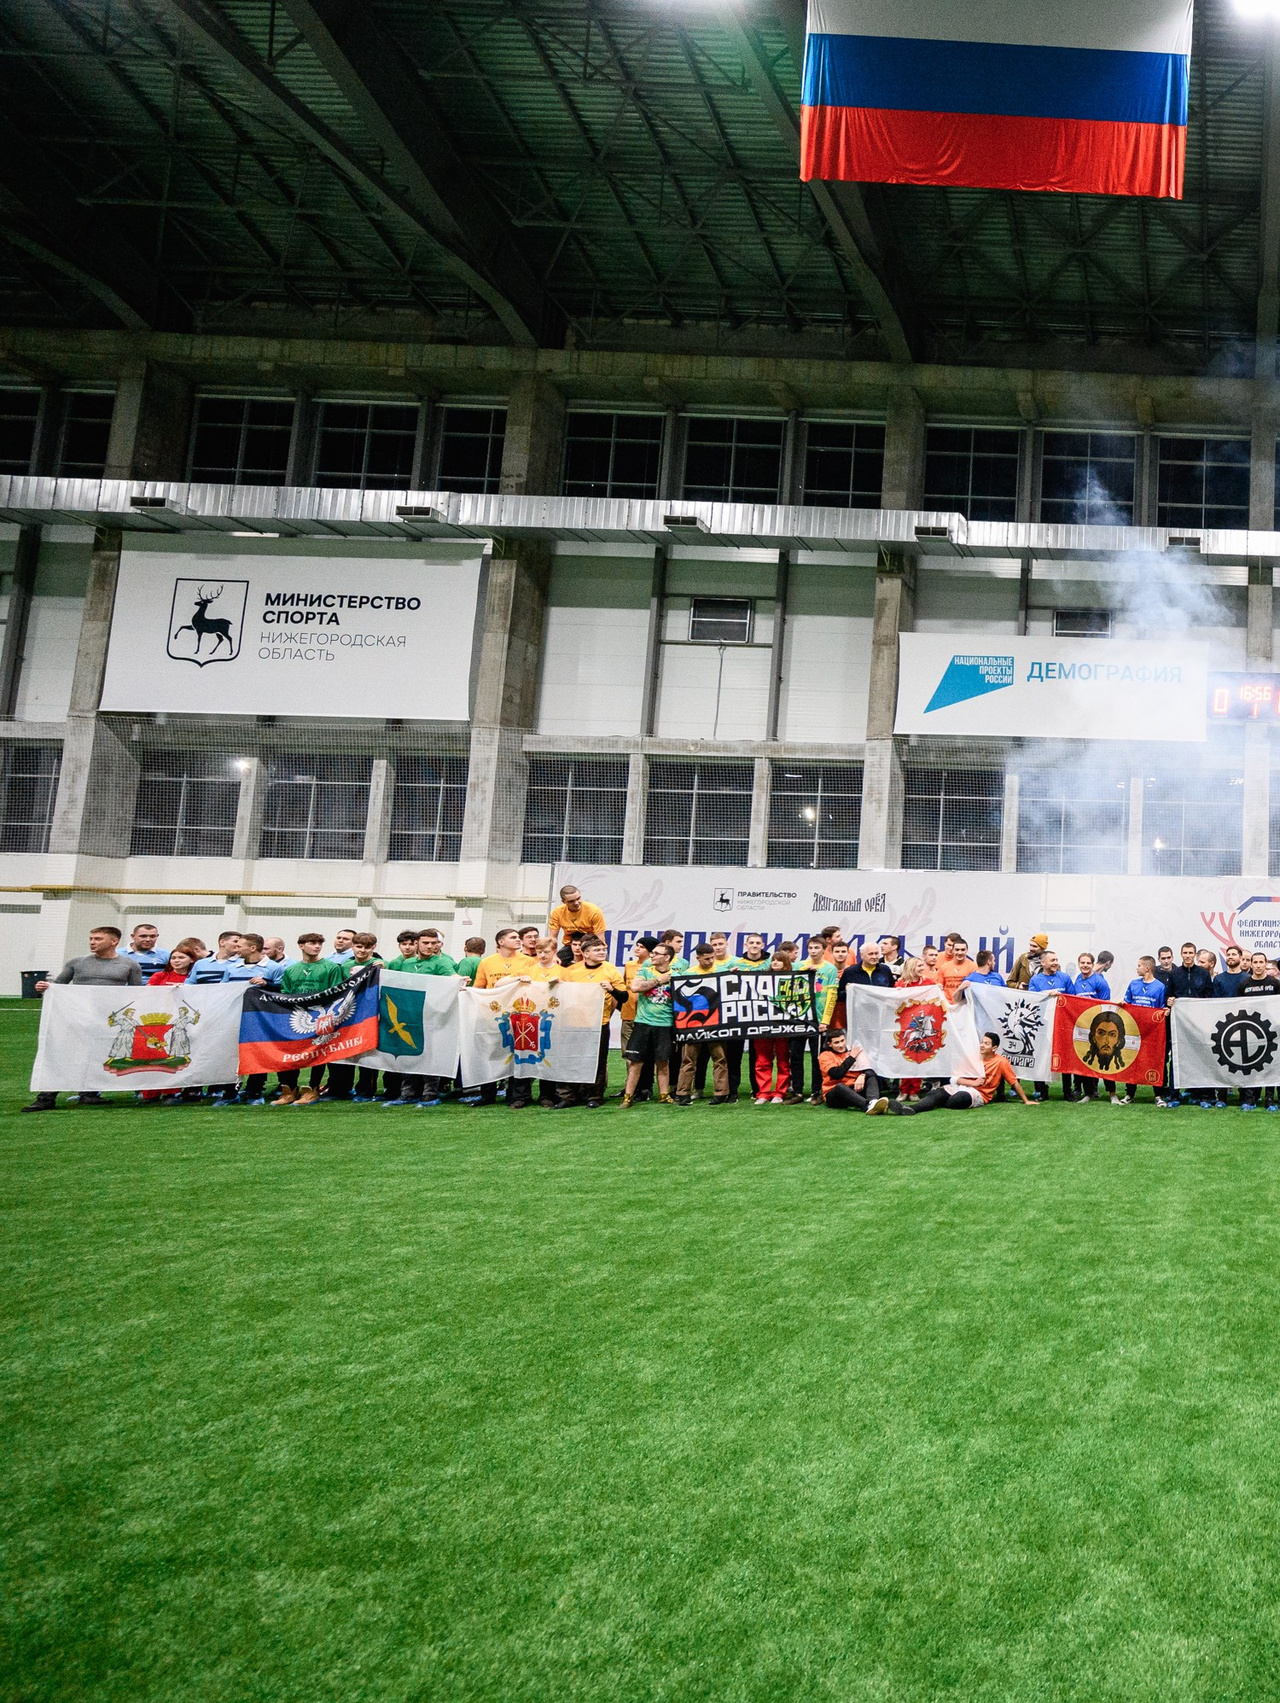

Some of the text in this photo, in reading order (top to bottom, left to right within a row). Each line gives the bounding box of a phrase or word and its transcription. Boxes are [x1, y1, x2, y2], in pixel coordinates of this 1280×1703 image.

[264, 592, 421, 611] МИНИСТЕРСТВО
[262, 610, 341, 626] СПОРТА
[260, 631, 407, 648] НИЖЕГОРОДСКАЯ
[258, 647, 335, 662] ОБЛАСТЬ
[954, 656, 1013, 667] НАЦИОНАЛЬНЫЕ
[979, 665, 1013, 675] ПРОЕКТЫ
[1026, 661, 1183, 684] ДЕМОГРАФИЯ
[984, 674, 1013, 685] РОССИИ
[1213, 688, 1229, 713] 0
[1239, 686, 1272, 701] 16:56
[737, 891, 798, 899] ПРАВИТЕЛЬСТВО
[675, 1024, 817, 1042] МАЙКОП ДРУЖБА
